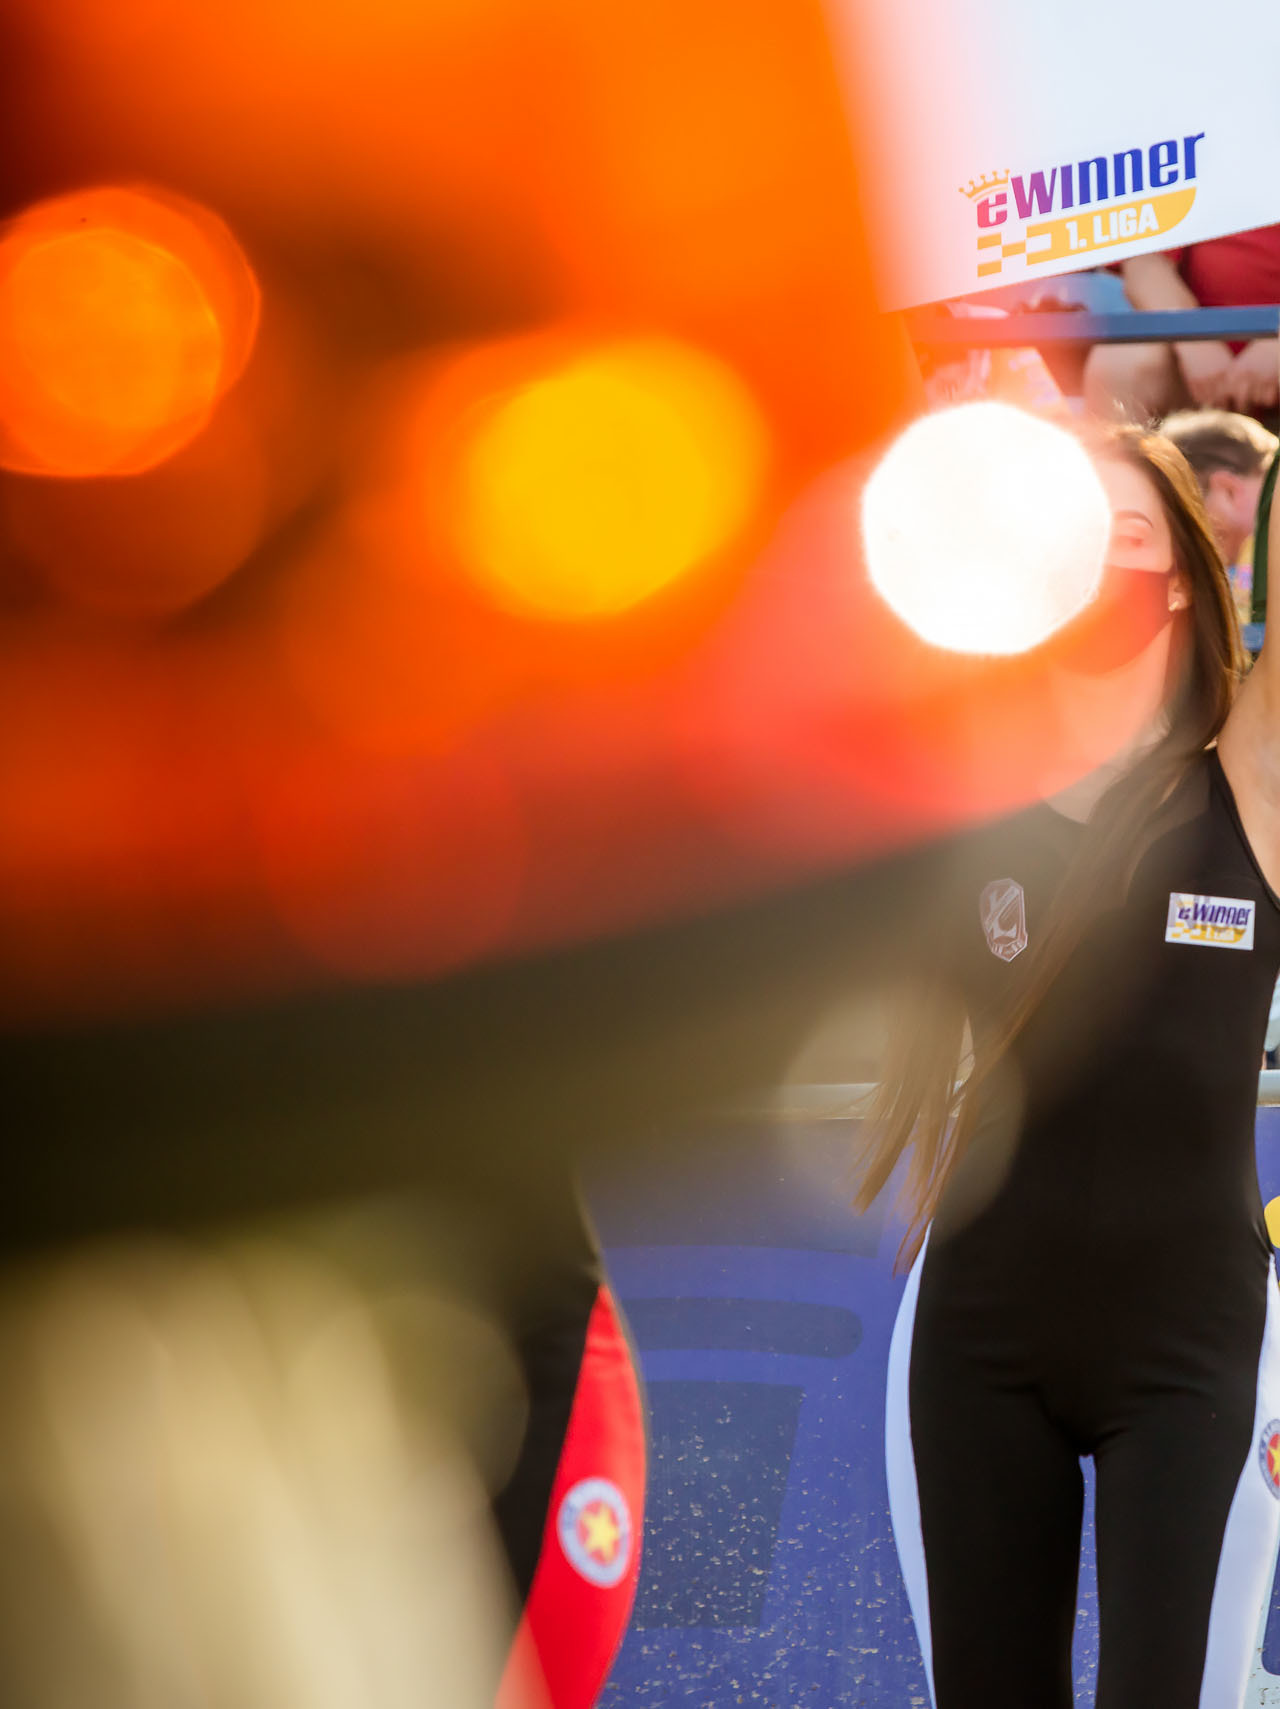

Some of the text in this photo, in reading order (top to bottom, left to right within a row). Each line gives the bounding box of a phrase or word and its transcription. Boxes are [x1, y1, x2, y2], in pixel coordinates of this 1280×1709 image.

[977, 132, 1205, 228] eWinner
[1066, 203, 1159, 250] 1. LIGA
